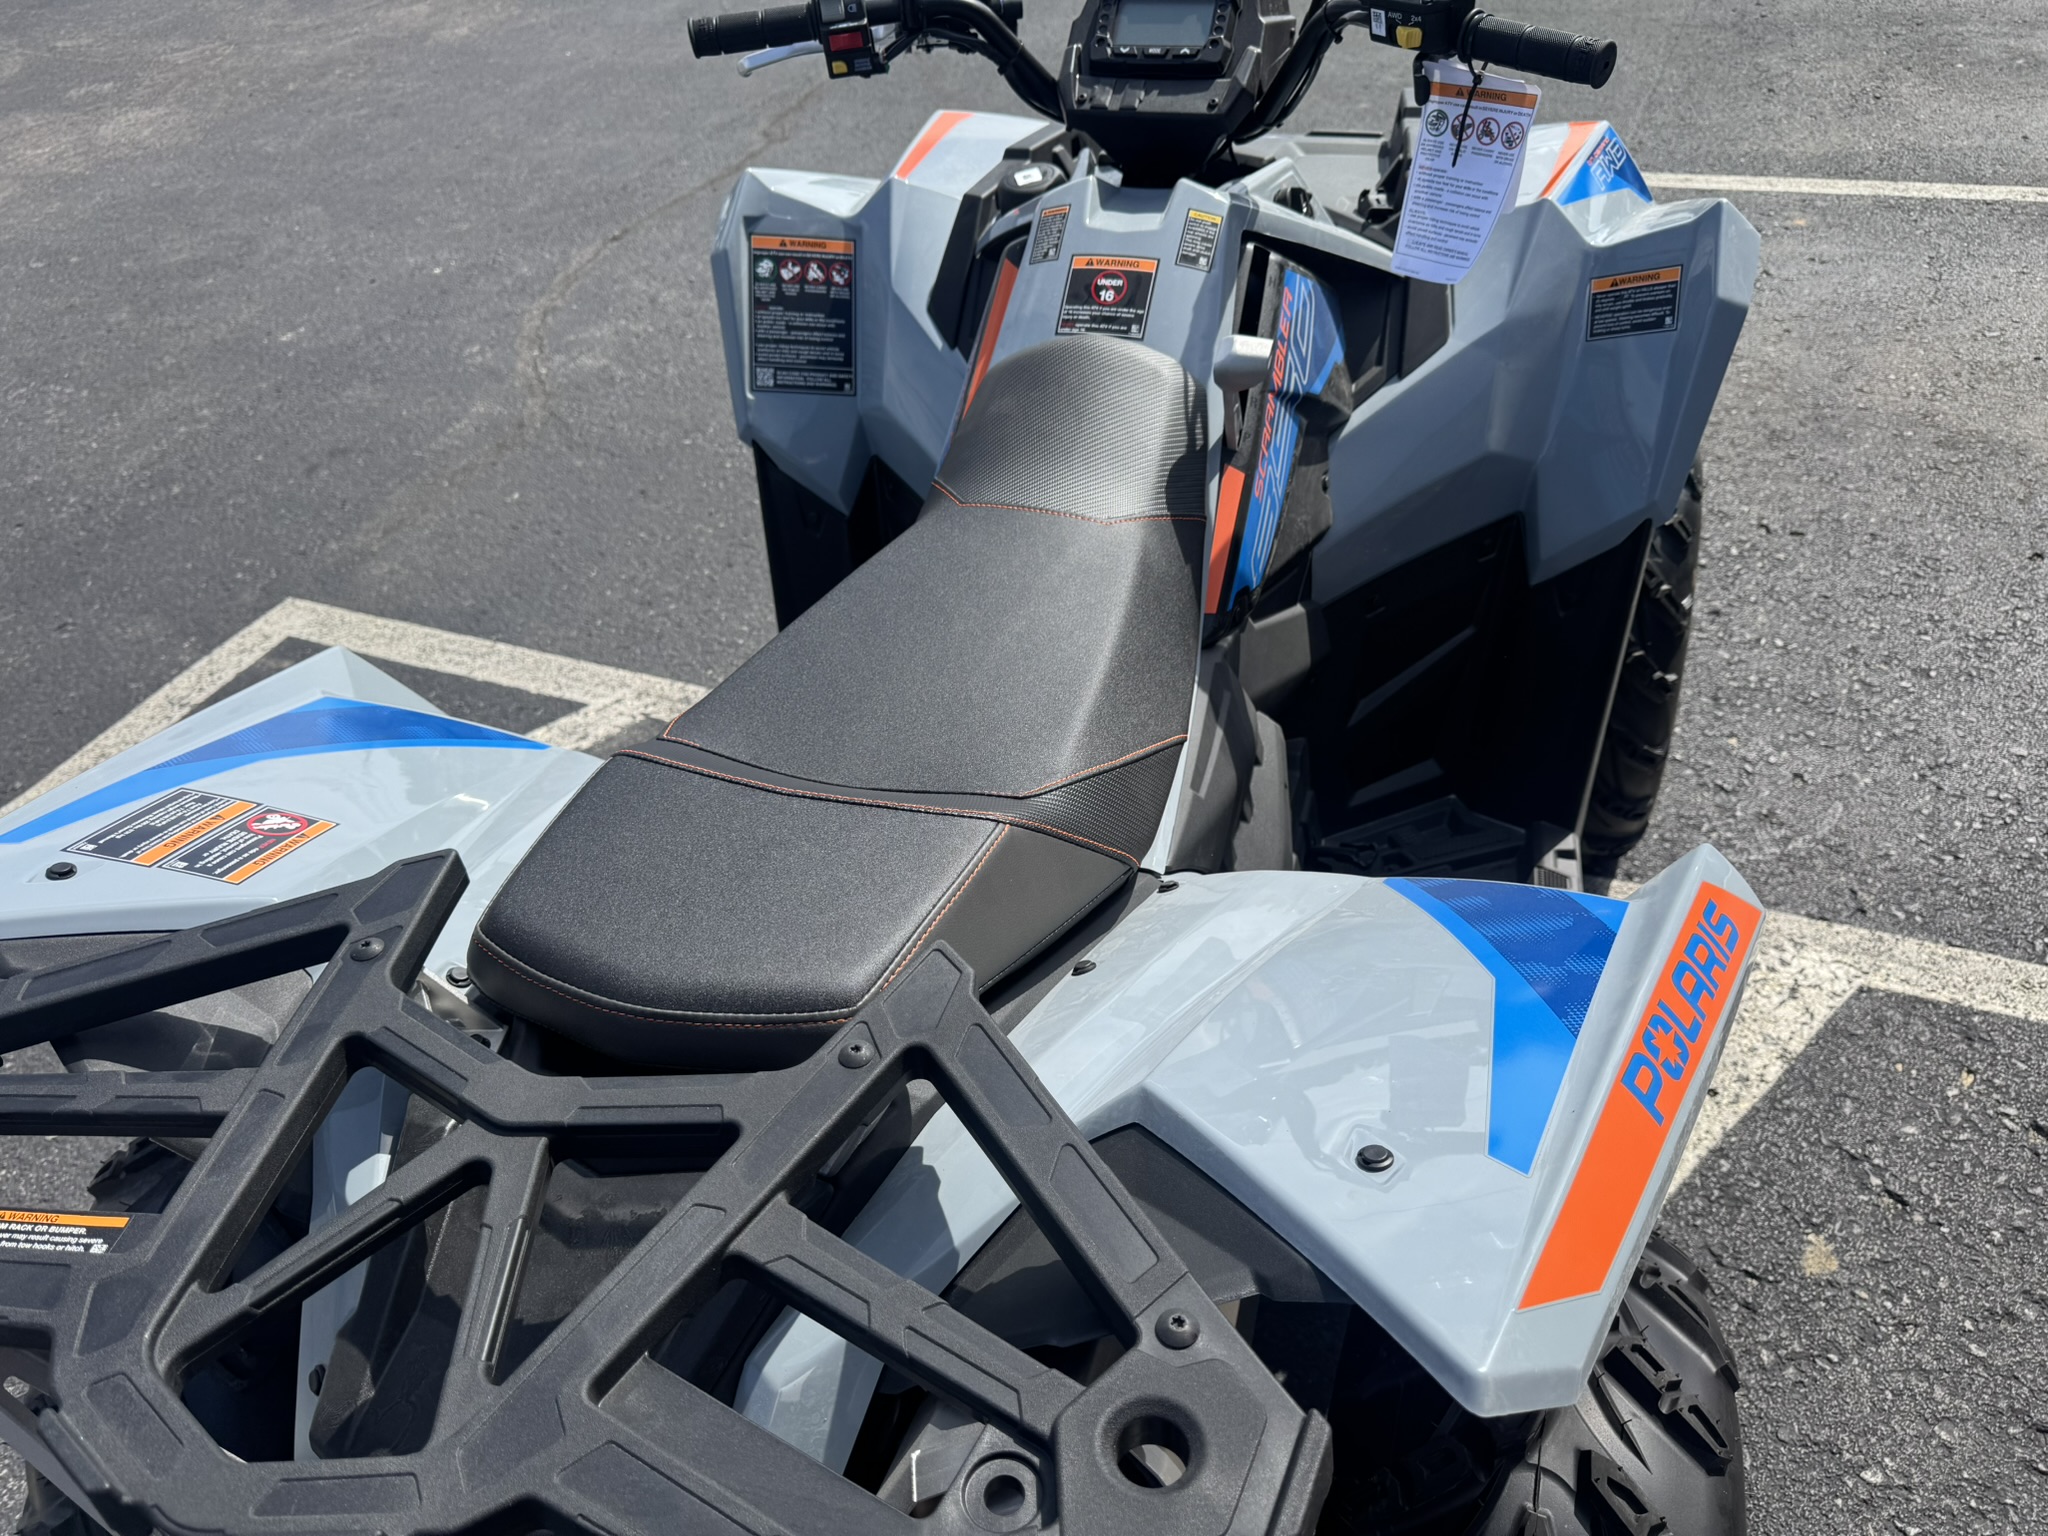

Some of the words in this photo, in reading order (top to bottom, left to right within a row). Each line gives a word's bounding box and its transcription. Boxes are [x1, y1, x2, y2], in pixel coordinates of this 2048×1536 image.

[1590, 137, 1626, 192] AWD
[789, 240, 827, 249] WARNING
[1096, 258, 1140, 268] WARNING
[1097, 278, 1123, 286] UNDER
[1619, 272, 1660, 285] WARNING
[1099, 289, 1115, 301] 16
[1254, 286, 1293, 503] SCRAMBLER
[161, 820, 218, 848] WARNING
[250, 838, 304, 866] WARNING
[1620, 898, 1741, 1128] POLARIS
[9, 1212, 60, 1223] WARNING
[8, 1223, 34, 1231] RACK
[48, 1227, 87, 1235] BUMPER.
[50, 1236, 77, 1244] causing
[33, 1242, 55, 1251] hooks
[65, 1244, 84, 1252] hitch.
